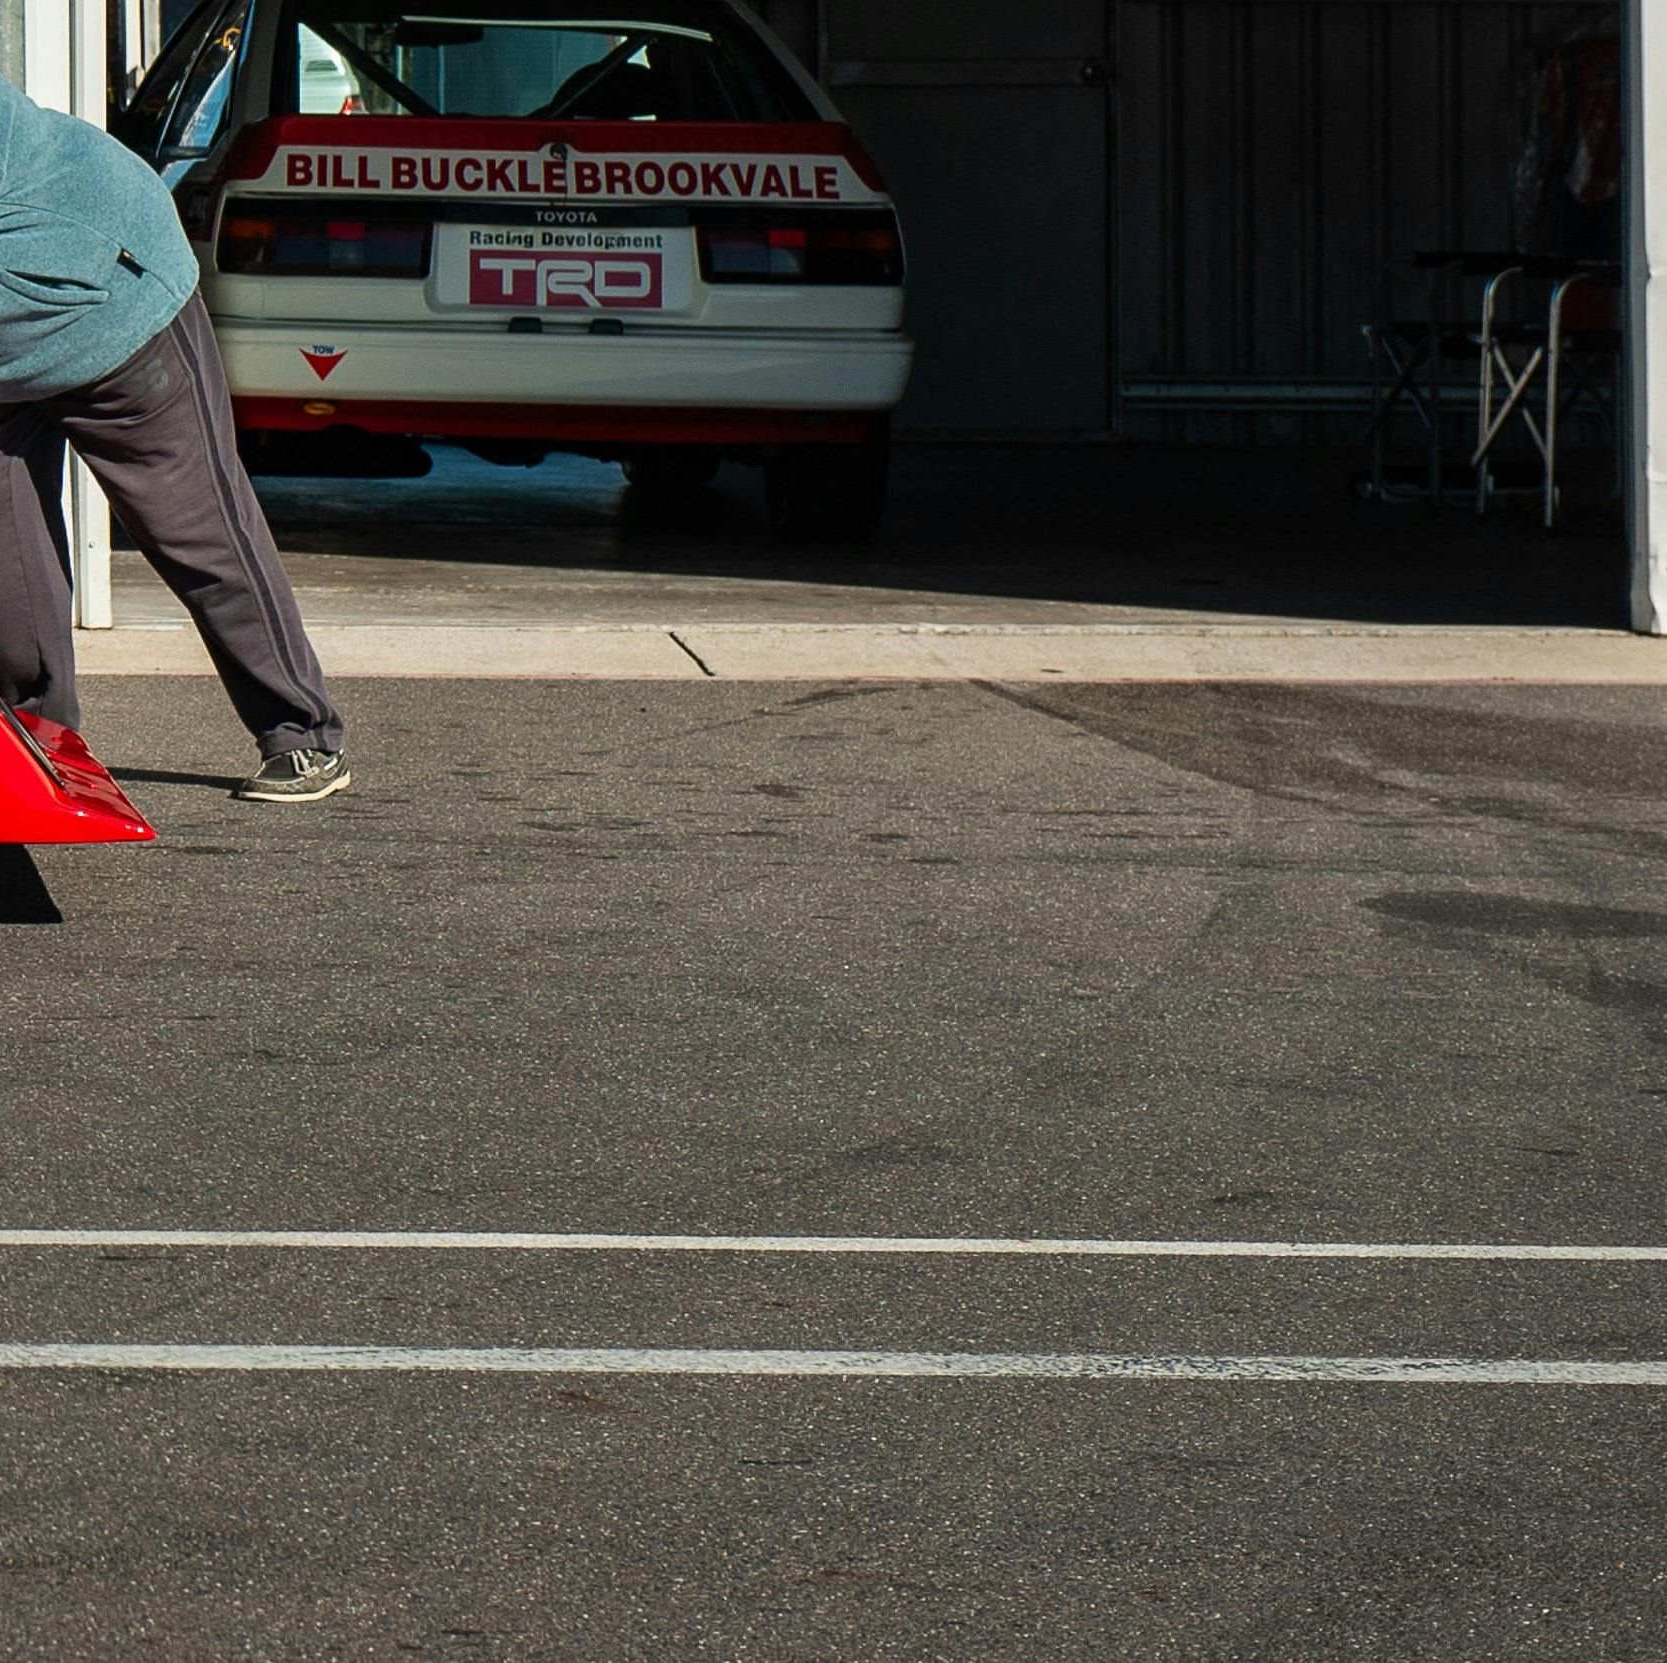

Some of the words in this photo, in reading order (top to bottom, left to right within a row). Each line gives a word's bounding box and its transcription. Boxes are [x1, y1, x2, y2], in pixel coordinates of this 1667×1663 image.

[285, 153, 381, 189] BILL
[390, 155, 567, 195] BUCKLE
[574, 159, 840, 200] BROOKVALE
[534, 210, 598, 224] TOYOTA
[469, 230, 534, 248] Racing
[541, 231, 663, 250] Development
[479, 258, 652, 309] TRD
